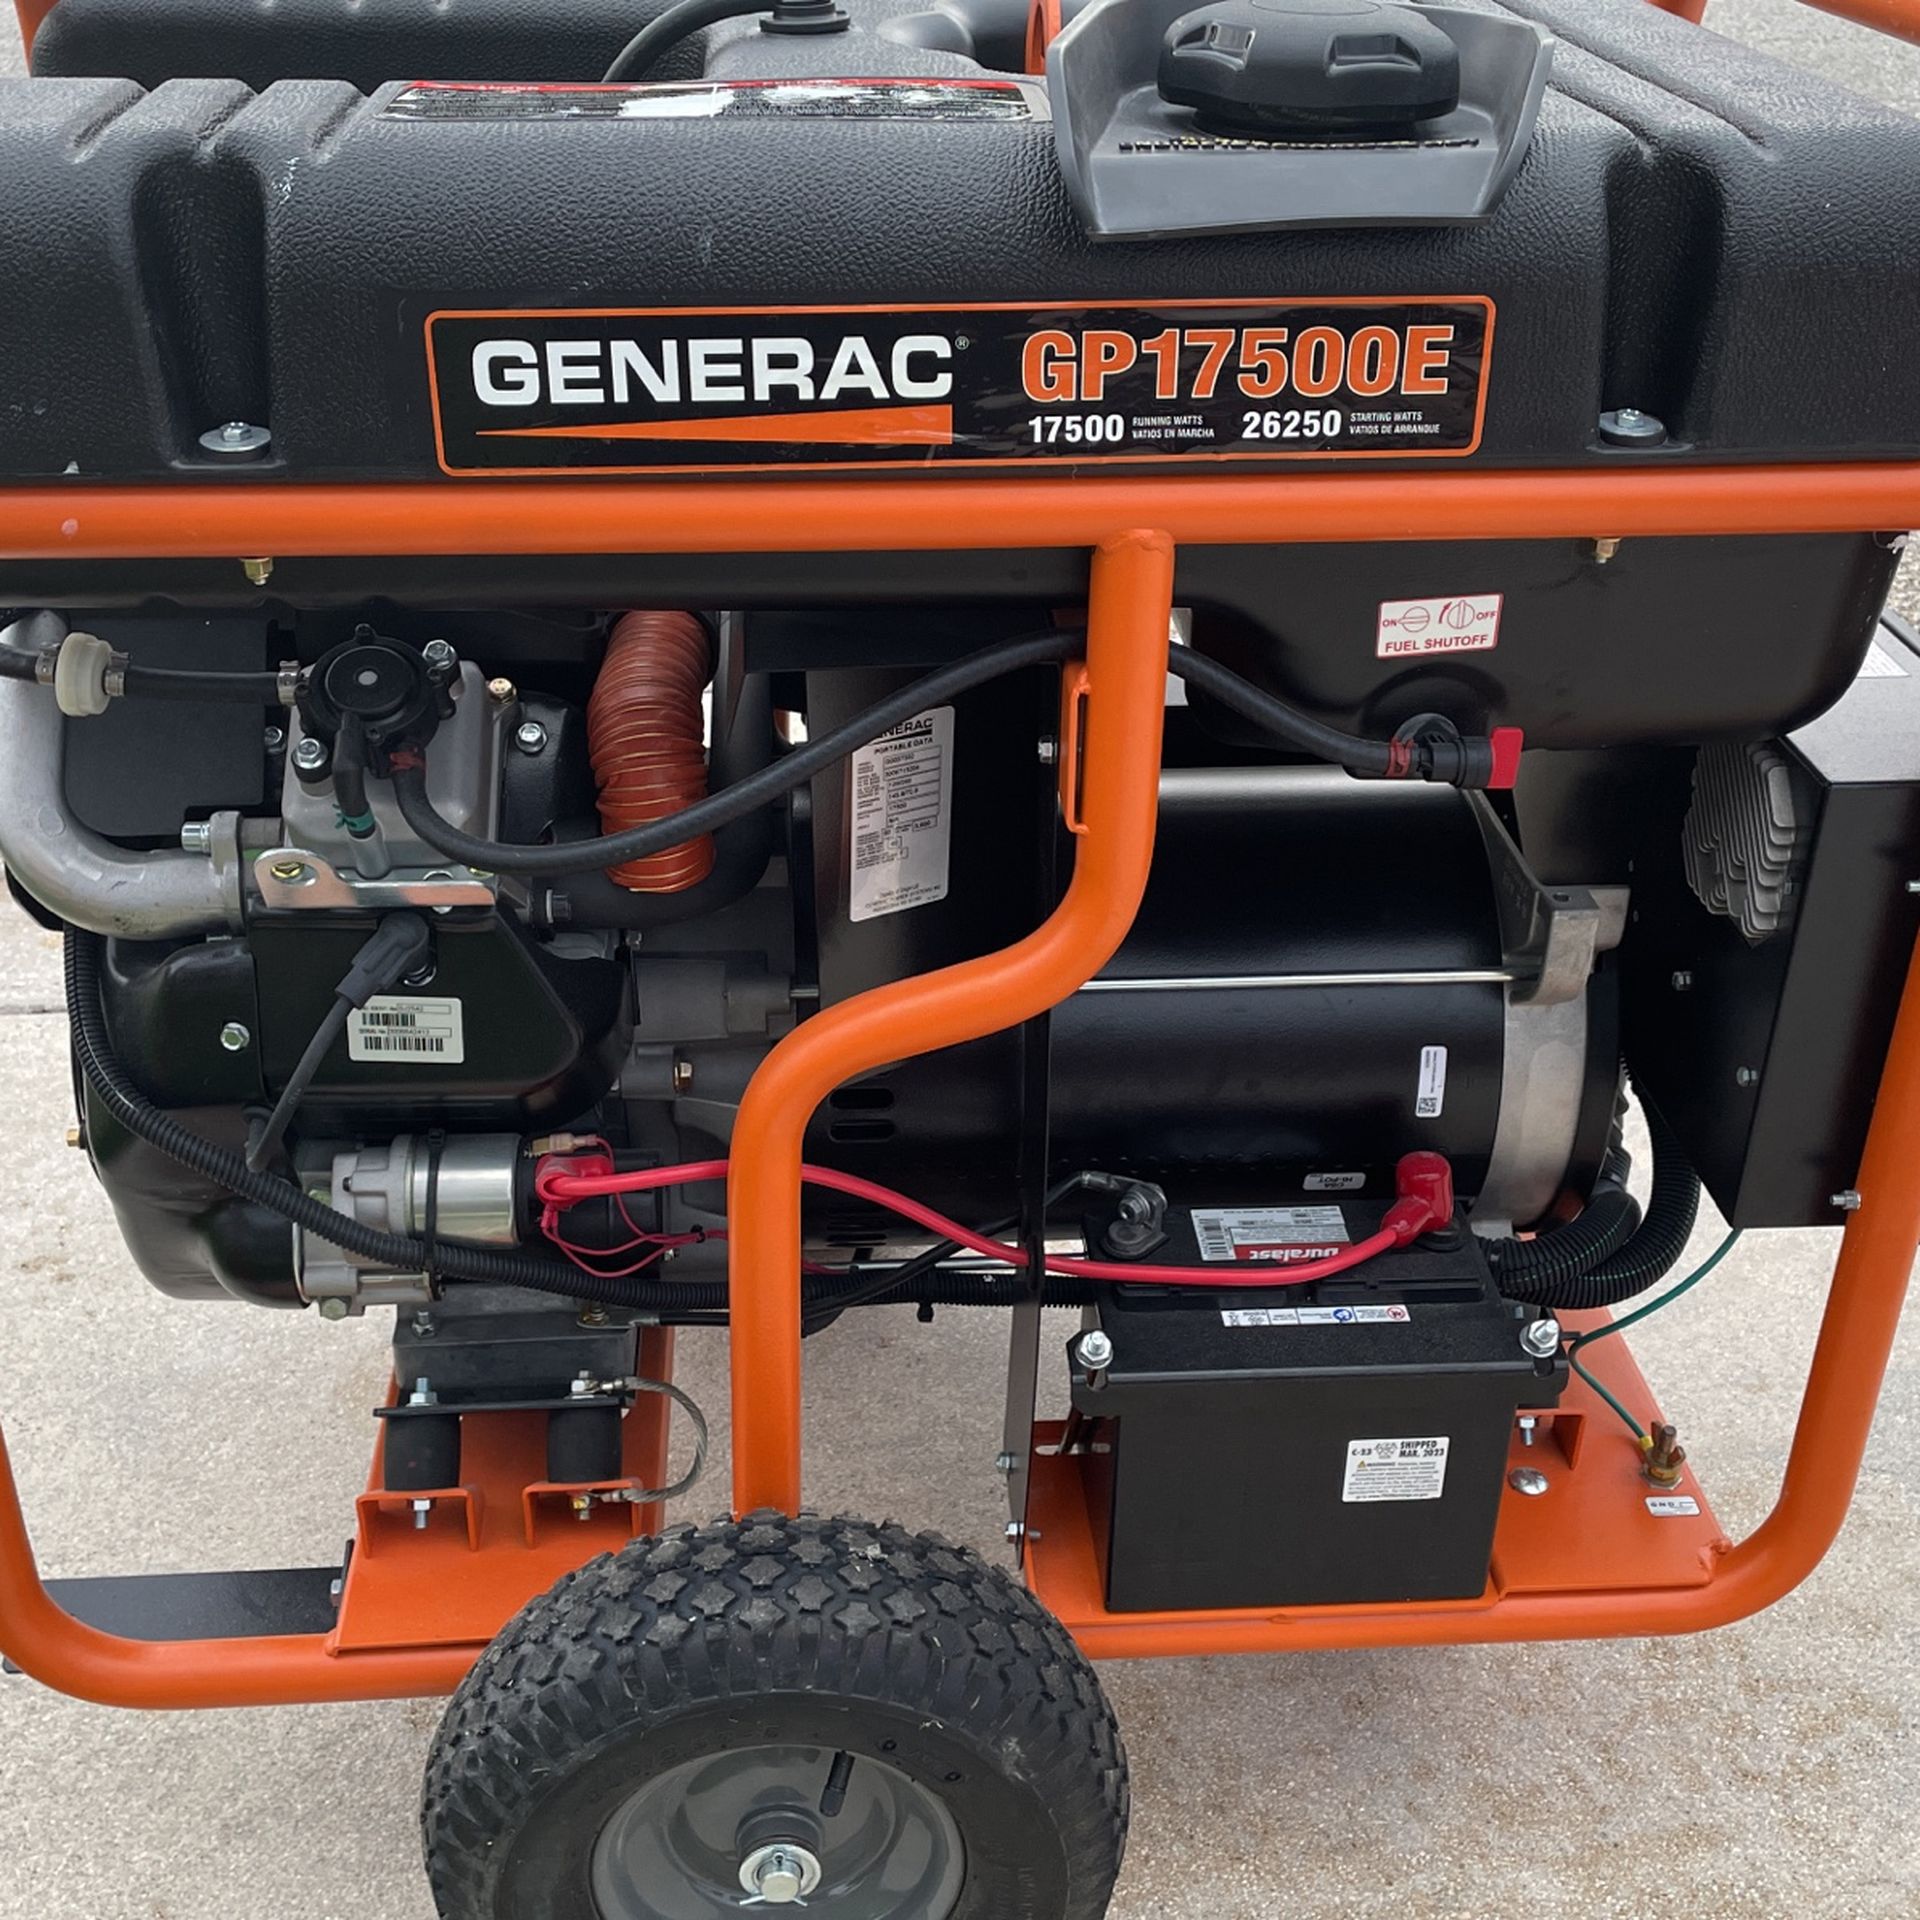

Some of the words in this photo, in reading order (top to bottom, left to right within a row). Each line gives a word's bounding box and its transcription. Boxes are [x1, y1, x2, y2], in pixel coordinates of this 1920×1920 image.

[1021, 325, 1454, 402] GP17500E
[472, 335, 953, 406] GENERAC
[1132, 417, 1171, 427] RUNNING
[1173, 415, 1203, 425] WATTS
[1350, 412, 1391, 422] STARTING
[1393, 411, 1422, 421] WATTS
[1028, 414, 1125, 443] 17500
[1241, 410, 1342, 438] 26250
[1349, 425, 1378, 435] VATIOS
[1380, 425, 1392, 434] DE
[1393, 424, 1440, 434] ARRANQUE
[1132, 429, 1162, 439] VATIOS
[1164, 428, 1175, 438] EN
[1177, 428, 1215, 438] MARCHA
[1476, 611, 1496, 621] OFF
[1382, 619, 1397, 627] ON
[1385, 640, 1420, 652] FUEL
[1425, 634, 1488, 649] SHUTOFF
[1400, 1440, 1437, 1450] SHIPPED
[1423, 1448, 1445, 1457] 2023
